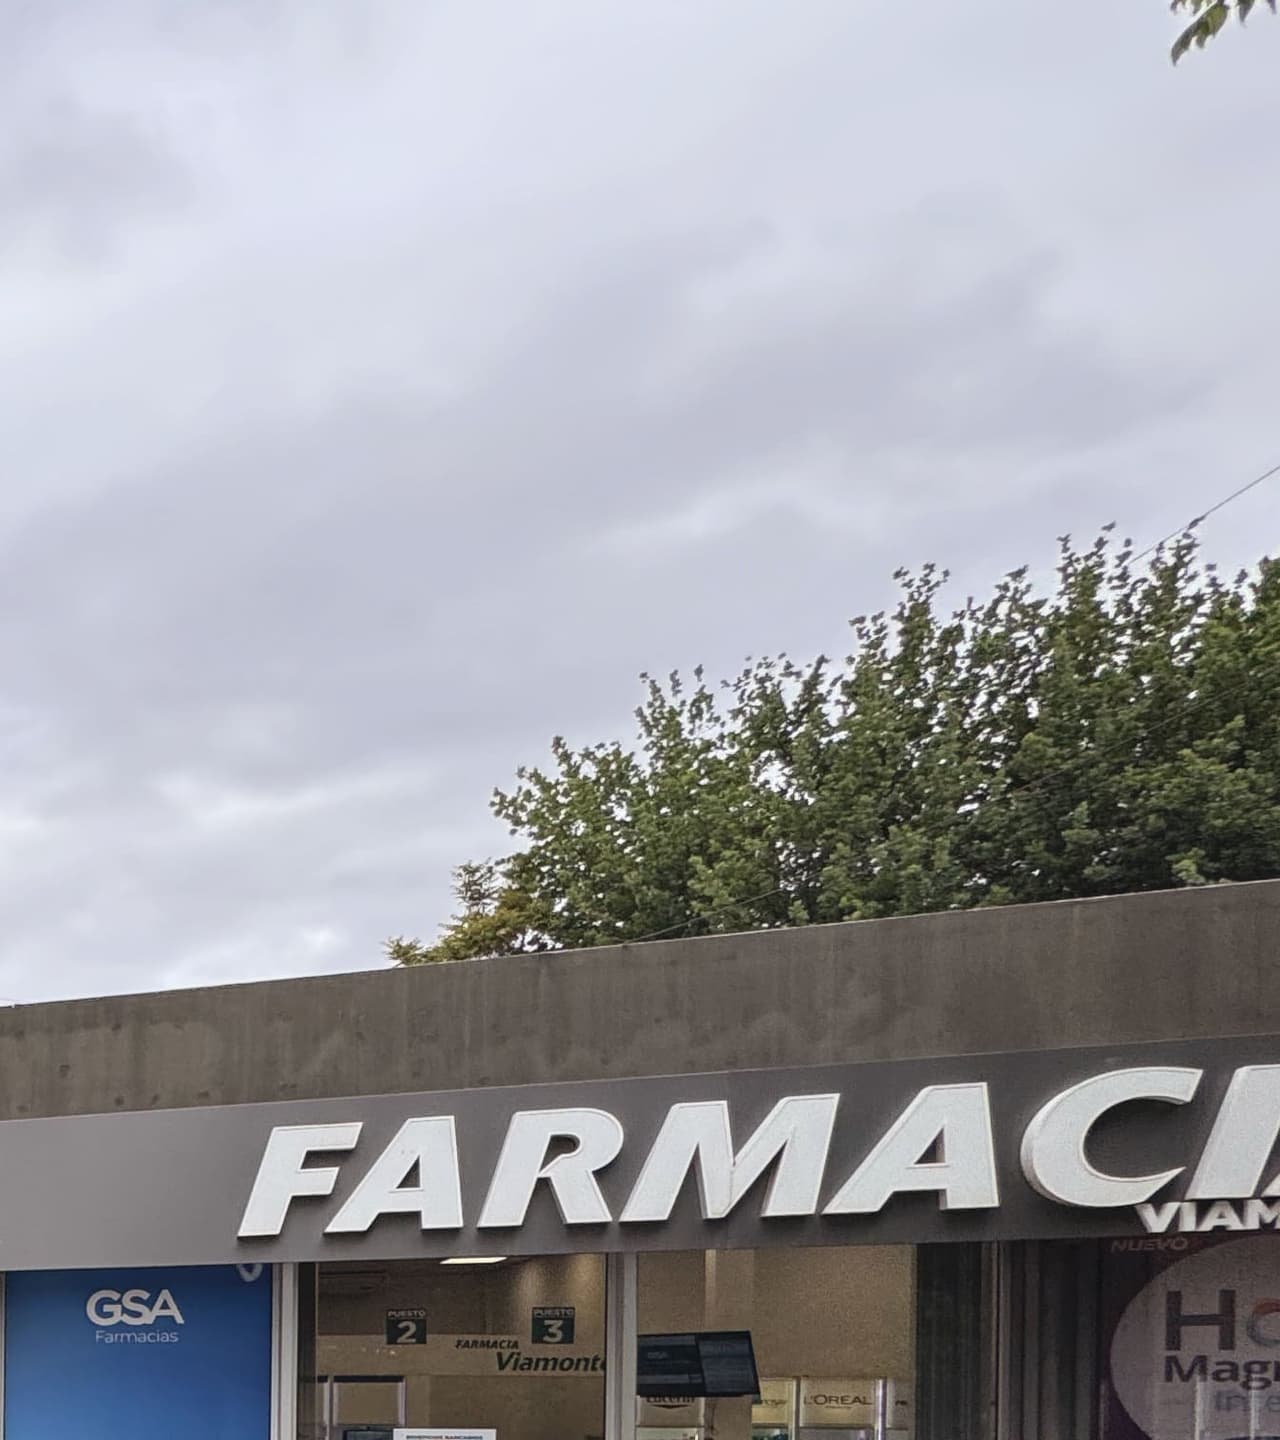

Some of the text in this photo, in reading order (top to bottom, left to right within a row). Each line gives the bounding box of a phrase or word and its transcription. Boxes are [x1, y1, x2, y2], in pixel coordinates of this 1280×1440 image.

[236, 1063, 1280, 1238] FARMACI
[1110, 1236, 1189, 1252] NUEVO
[85, 1288, 185, 1327] GSA
[387, 1310, 427, 1318] PUESTO
[95, 1329, 180, 1344] Farmacias
[395, 1320, 418, 1344] 2
[542, 1319, 564, 1343] 3
[455, 1339, 520, 1350] FARMACIA
[1163, 1354, 1280, 1391] Mag
